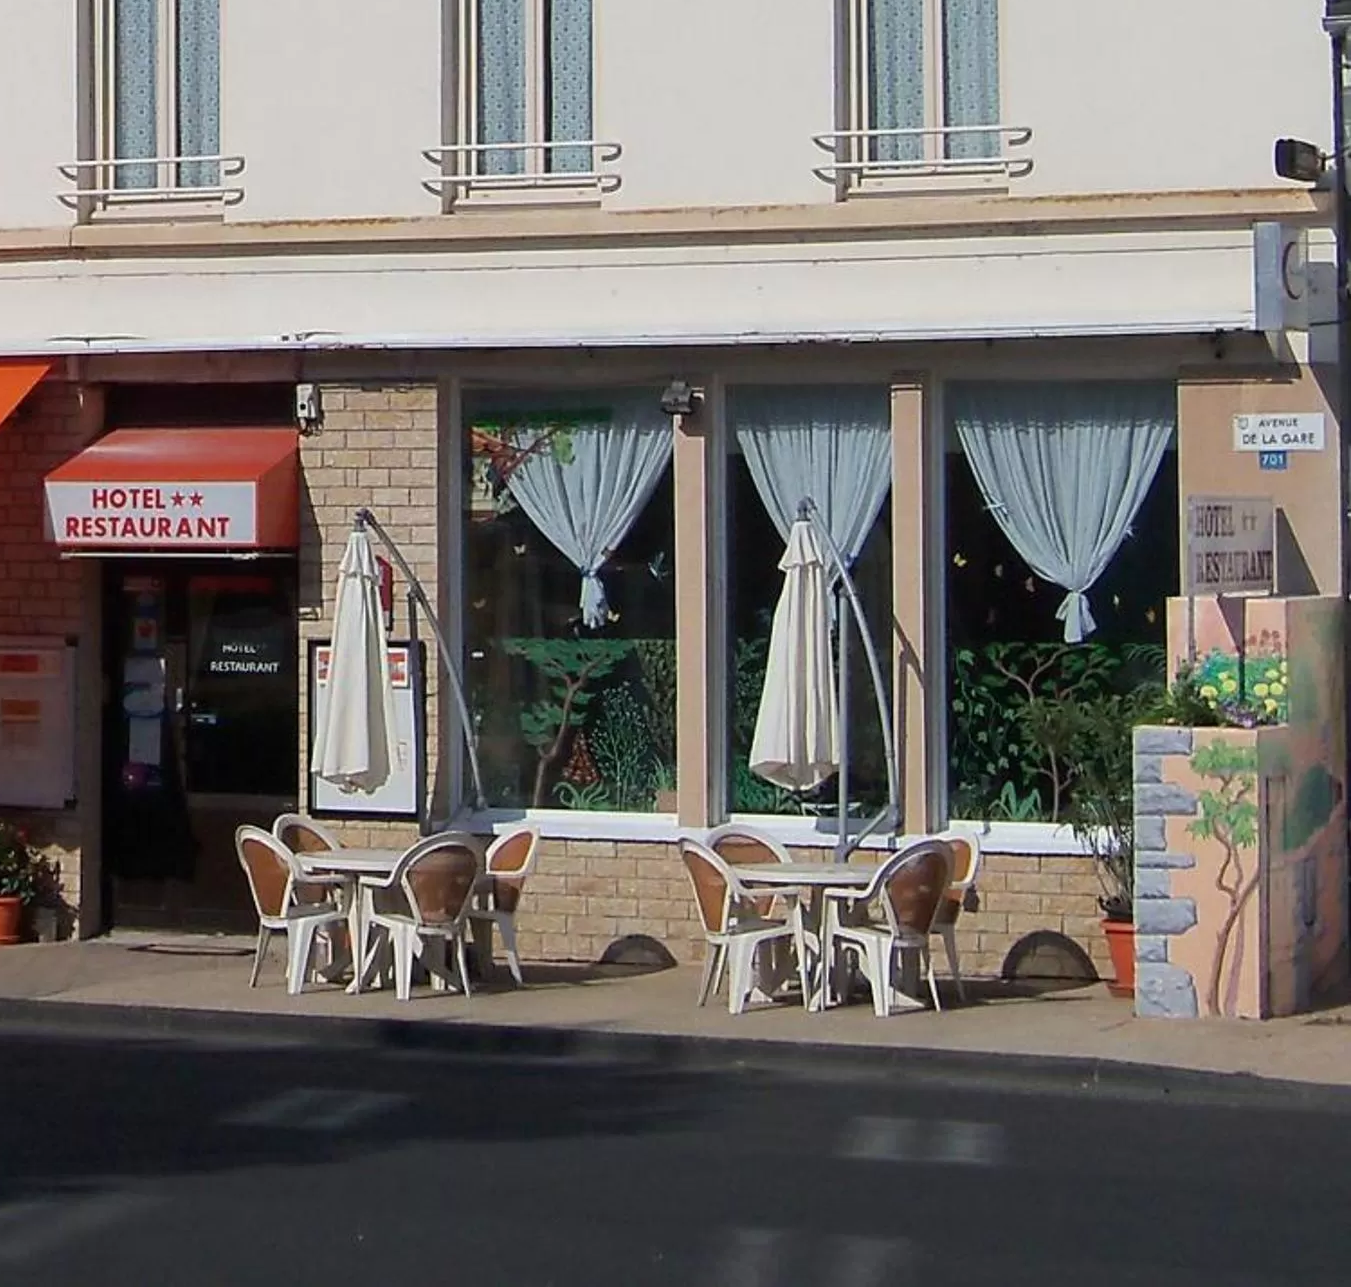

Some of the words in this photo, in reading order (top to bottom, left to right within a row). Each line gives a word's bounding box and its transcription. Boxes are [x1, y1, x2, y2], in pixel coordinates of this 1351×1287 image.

[1259, 418, 1298, 428] AVENUE
[1242, 434, 1257, 444] DE
[1262, 434, 1277, 444] LA
[1281, 433, 1315, 444] GARE
[1262, 454, 1284, 466] 701
[92, 489, 166, 509] HOTEL
[66, 517, 230, 538] RESTAURANT
[1195, 550, 1272, 583] RESTAURANT
[210, 660, 280, 673] RESTAURANT
